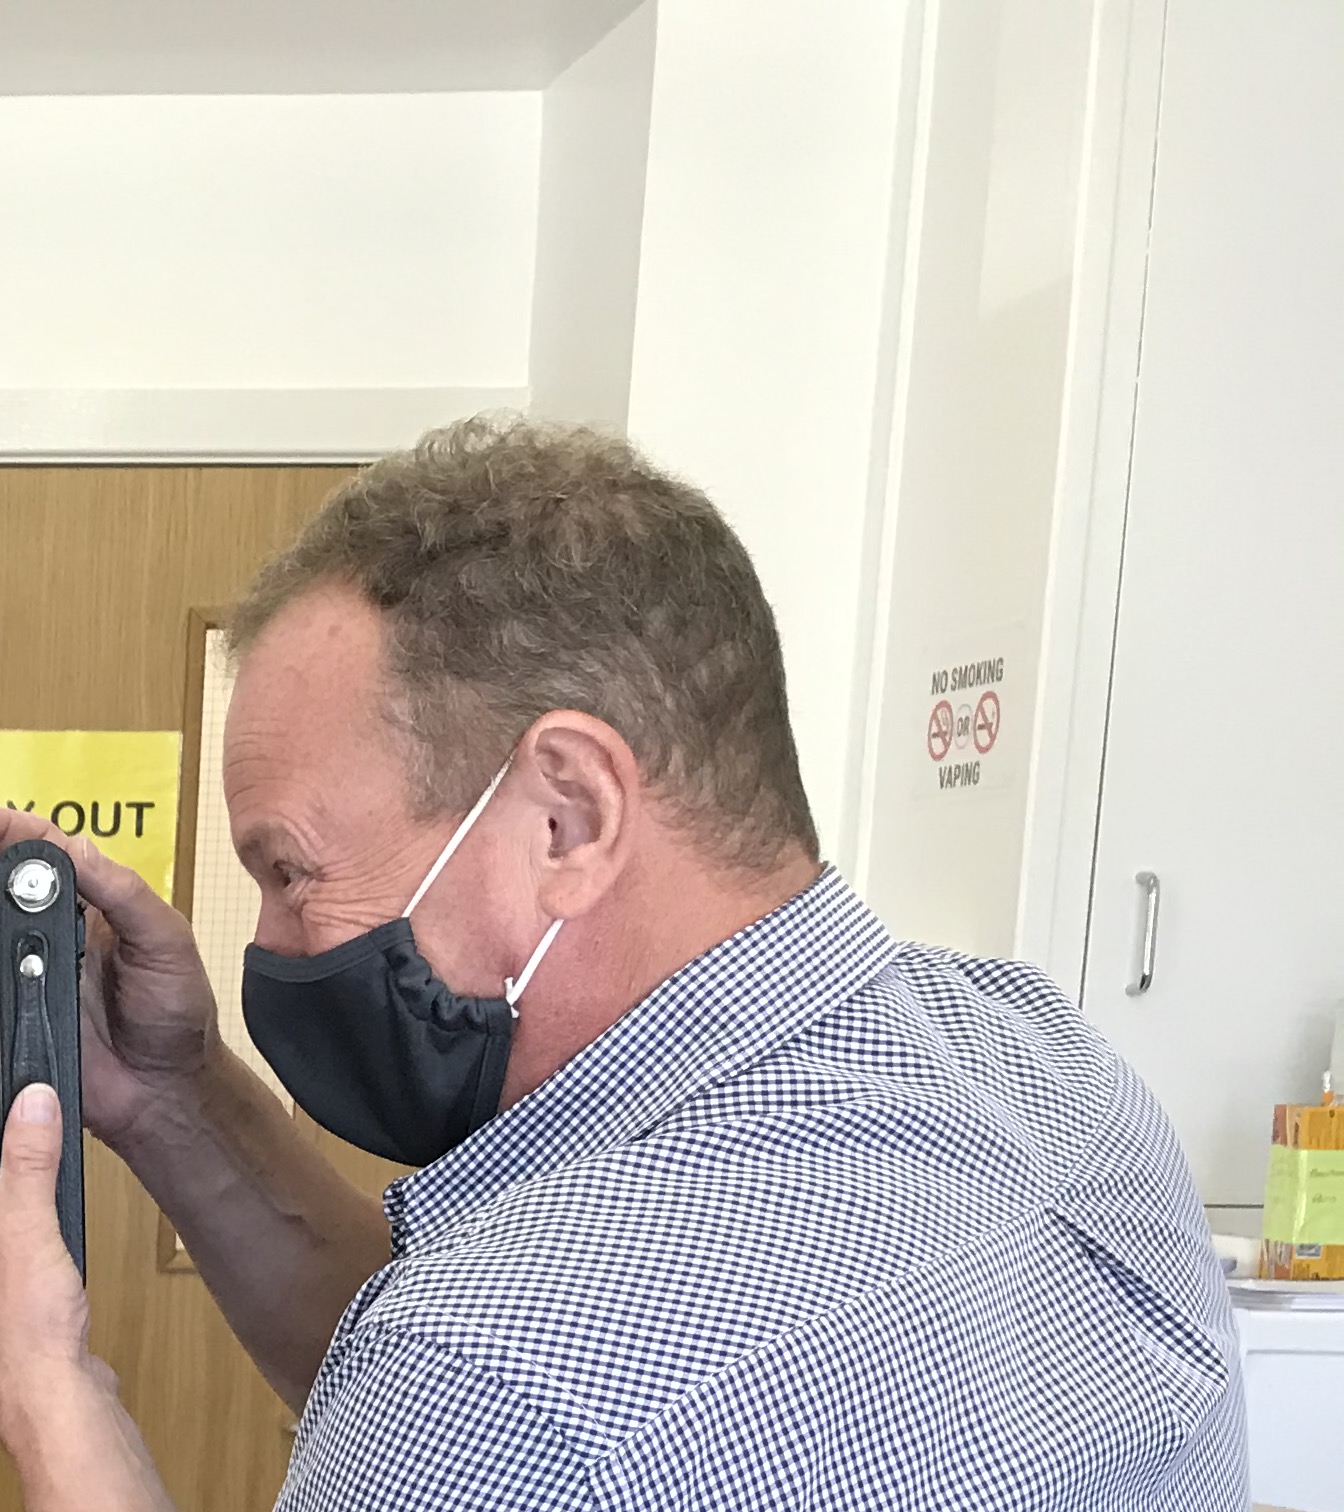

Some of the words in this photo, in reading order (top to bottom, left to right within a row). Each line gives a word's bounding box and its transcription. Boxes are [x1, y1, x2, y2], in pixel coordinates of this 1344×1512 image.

[931, 670, 948, 695] NO
[951, 657, 1004, 691] SMOKING
[957, 716, 970, 737] OR
[939, 761, 980, 789] VAPING
[51, 800, 156, 838] OUT
